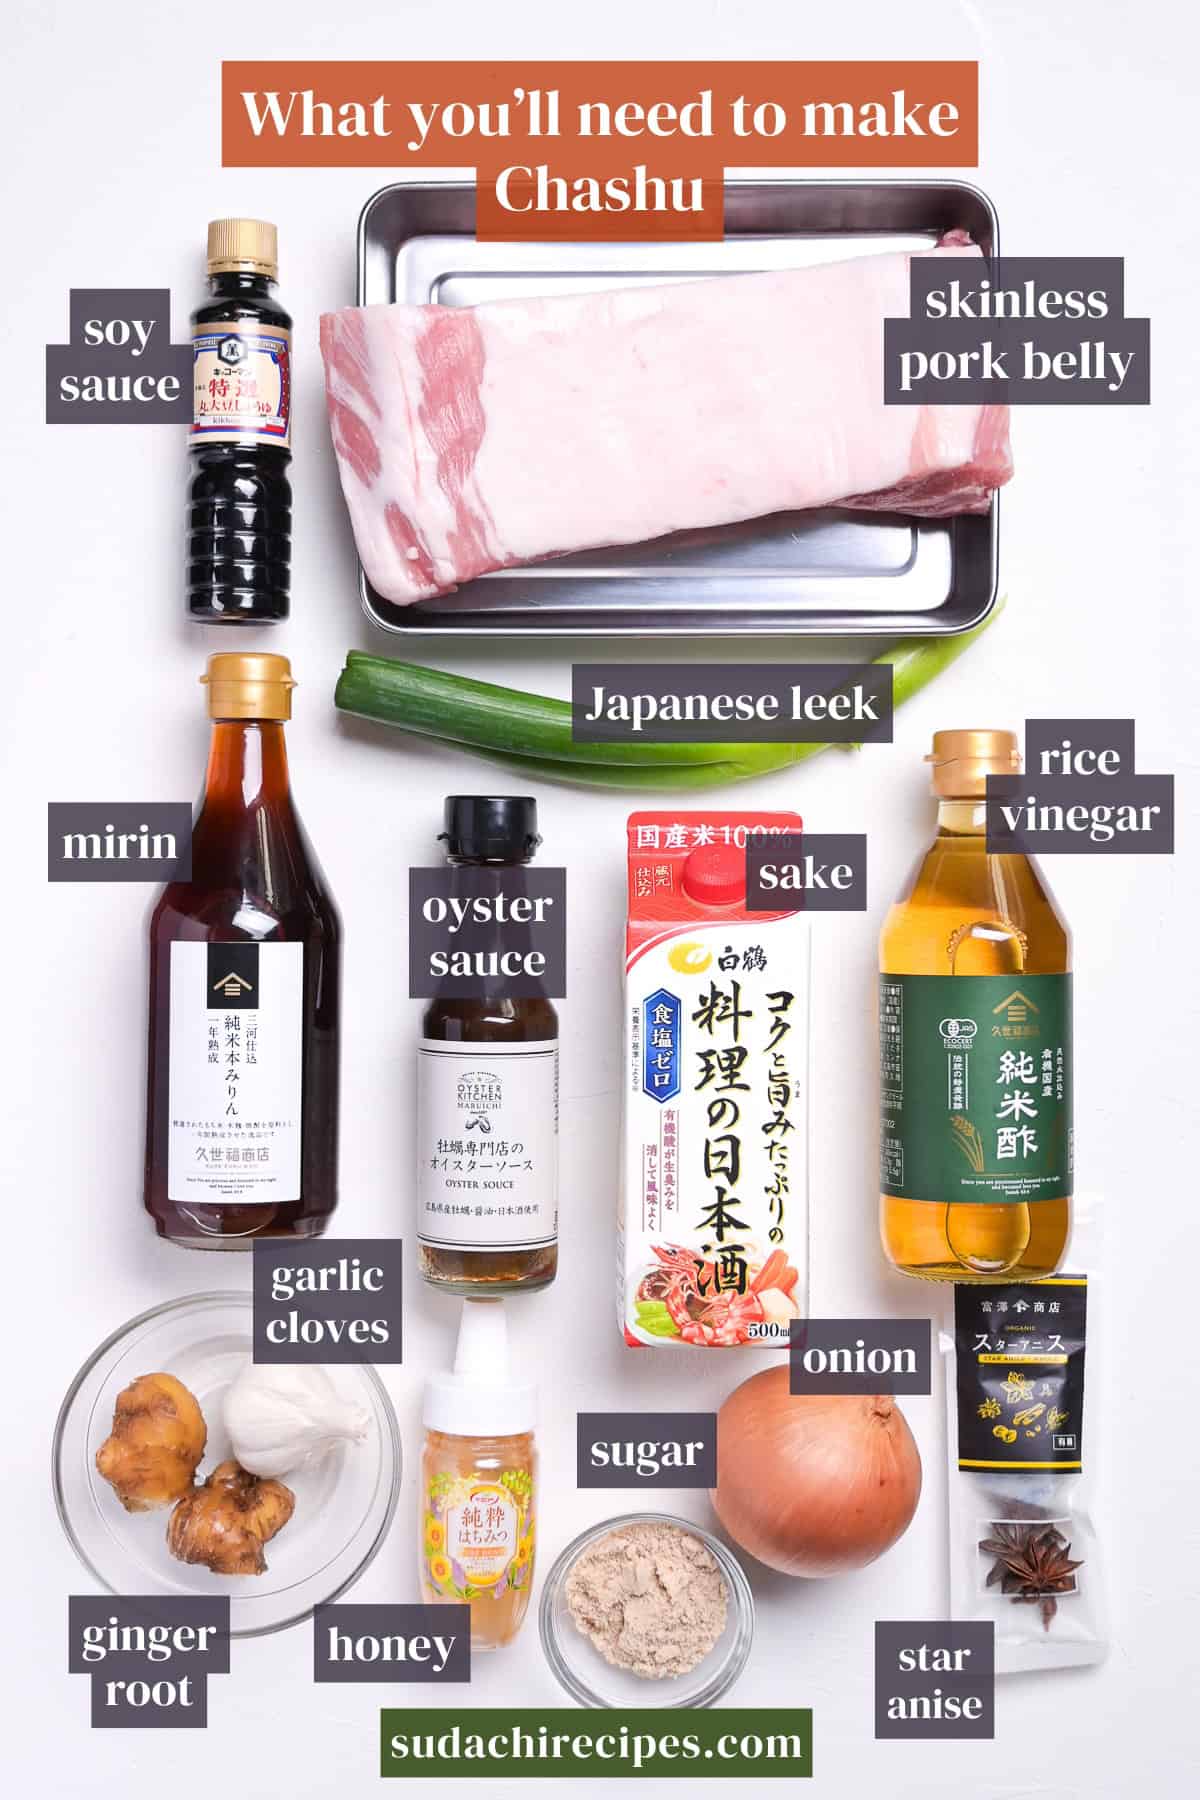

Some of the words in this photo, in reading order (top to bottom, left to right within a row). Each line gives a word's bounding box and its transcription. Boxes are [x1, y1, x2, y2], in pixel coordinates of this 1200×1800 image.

[637, 867, 652, 897] 仕込み
[718, 945, 768, 972] 白鶴
[207, 1018, 220, 1064] 一年熟成
[245, 1015, 258, 1064] 三河仕込
[651, 1003, 674, 1087] 食塩ゼロ
[224, 1015, 241, 1116] 純米本みりん
[1041, 1048, 1053, 1097] 有機国産
[457, 1084, 502, 1093] OYSTER
[457, 1092, 502, 1101] KITCHEN
[457, 1102, 501, 1110] MARUICHI
[762, 990, 796, 1244] コクと旨みたっぷりの
[995, 1050, 1039, 1160] 純米酢
[437, 1138, 523, 1156] 牡蠣専門店の
[692, 980, 753, 1297] 料理の日本酒
[195, 1146, 270, 1162] 久世福商店
[430, 1159, 533, 1172] オイスターソース
[445, 1179, 479, 1189] OYSTER
[483, 1180, 514, 1189] SOUCE
[972, 1333, 1065, 1352] スターアニス
[461, 1506, 505, 1529] 純粋
[458, 1530, 509, 1545] はちみつ
